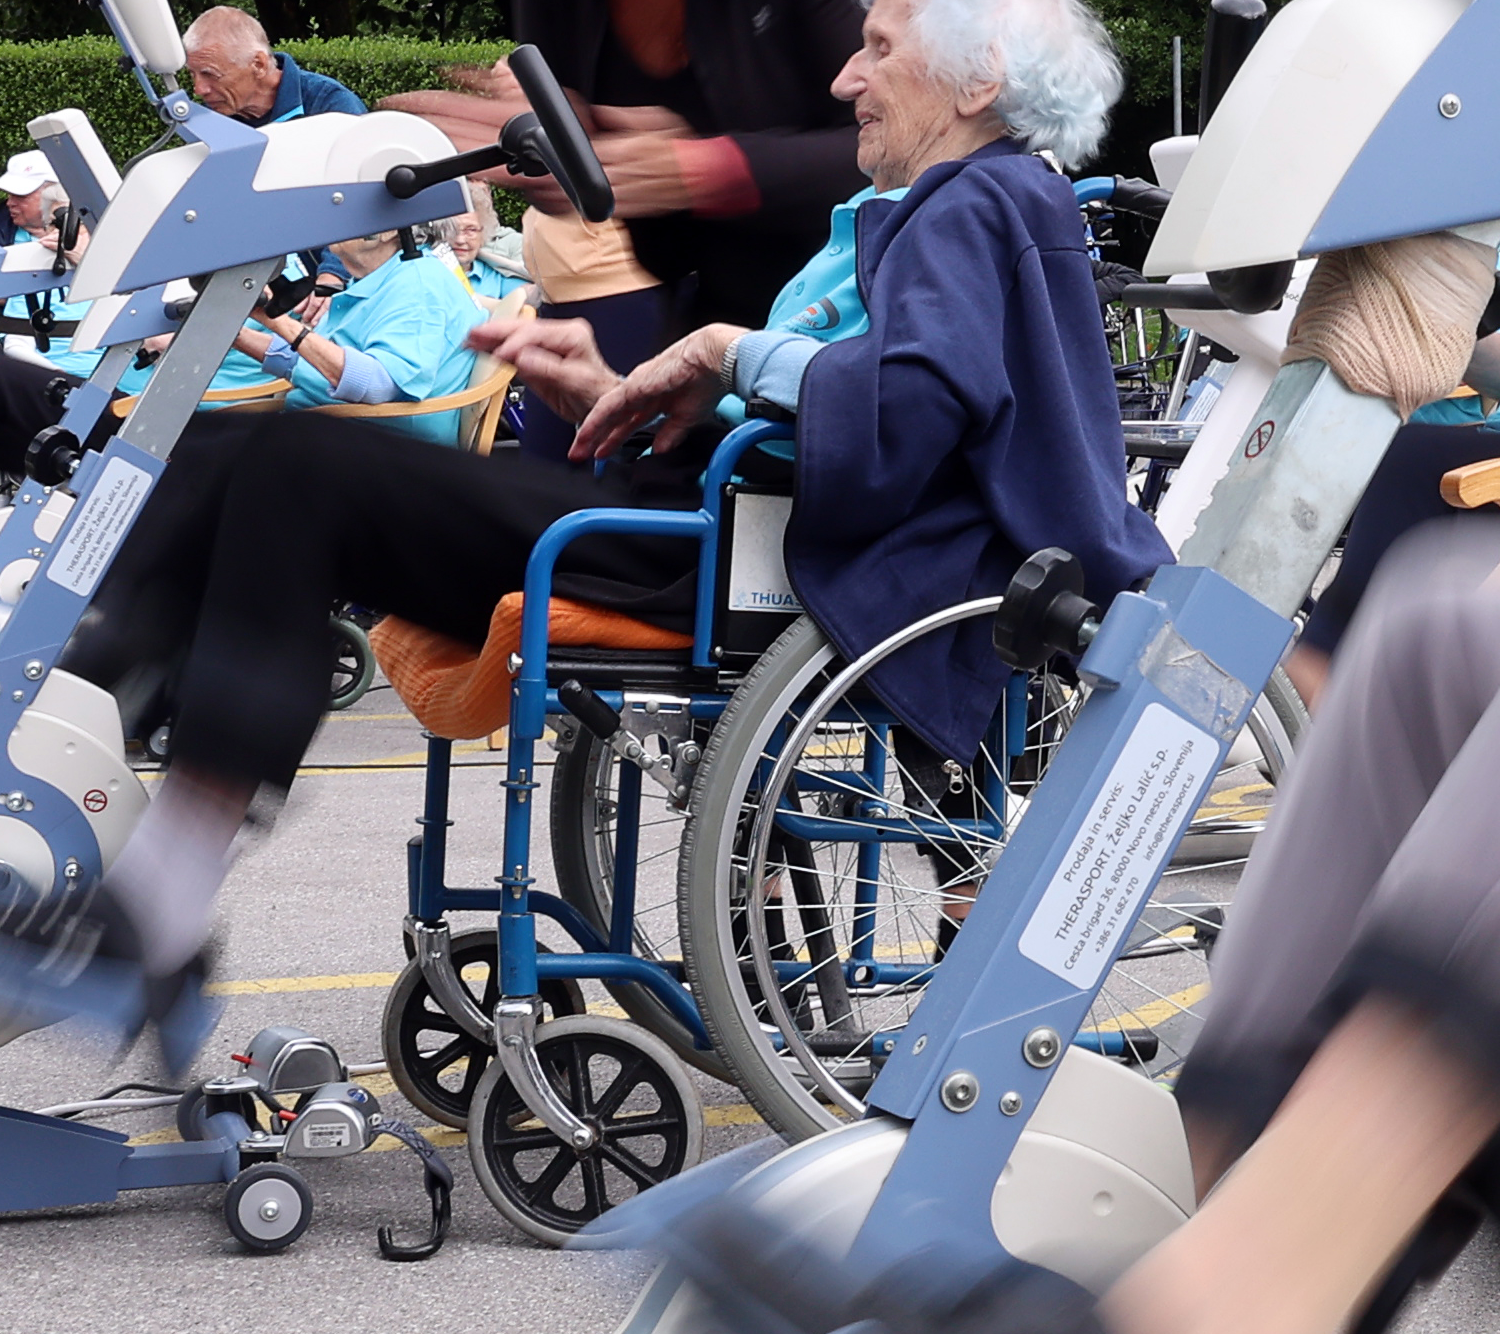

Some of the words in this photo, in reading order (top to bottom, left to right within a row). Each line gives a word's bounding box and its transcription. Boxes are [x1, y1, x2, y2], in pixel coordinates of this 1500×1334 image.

[1057, 848, 1112, 939] THERASPORT,
[1105, 801, 1138, 845] Željko
[1130, 770, 1155, 801] Lalić
[1150, 746, 1169, 771] s.p.
[1063, 939, 1086, 969] Cesta
[1080, 903, 1106, 938] brigad
[1101, 884, 1116, 902] 36,
[1110, 855, 1131, 883] 8000
[1126, 825, 1147, 855] Novo
[1143, 789, 1168, 824] mesto,
[1163, 739, 1193, 786] Slovenija
[1064, 835, 1095, 882] Prodaja
[1089, 821, 1101, 834] in
[1097, 782, 1123, 820] servis:
[1093, 929, 1111, 953] +386
[1106, 916, 1118, 929] 31
[1114, 896, 1129, 915] 682
[1124, 876, 1139, 895] 470
[1144, 776, 1194, 858] info@therasport.si
